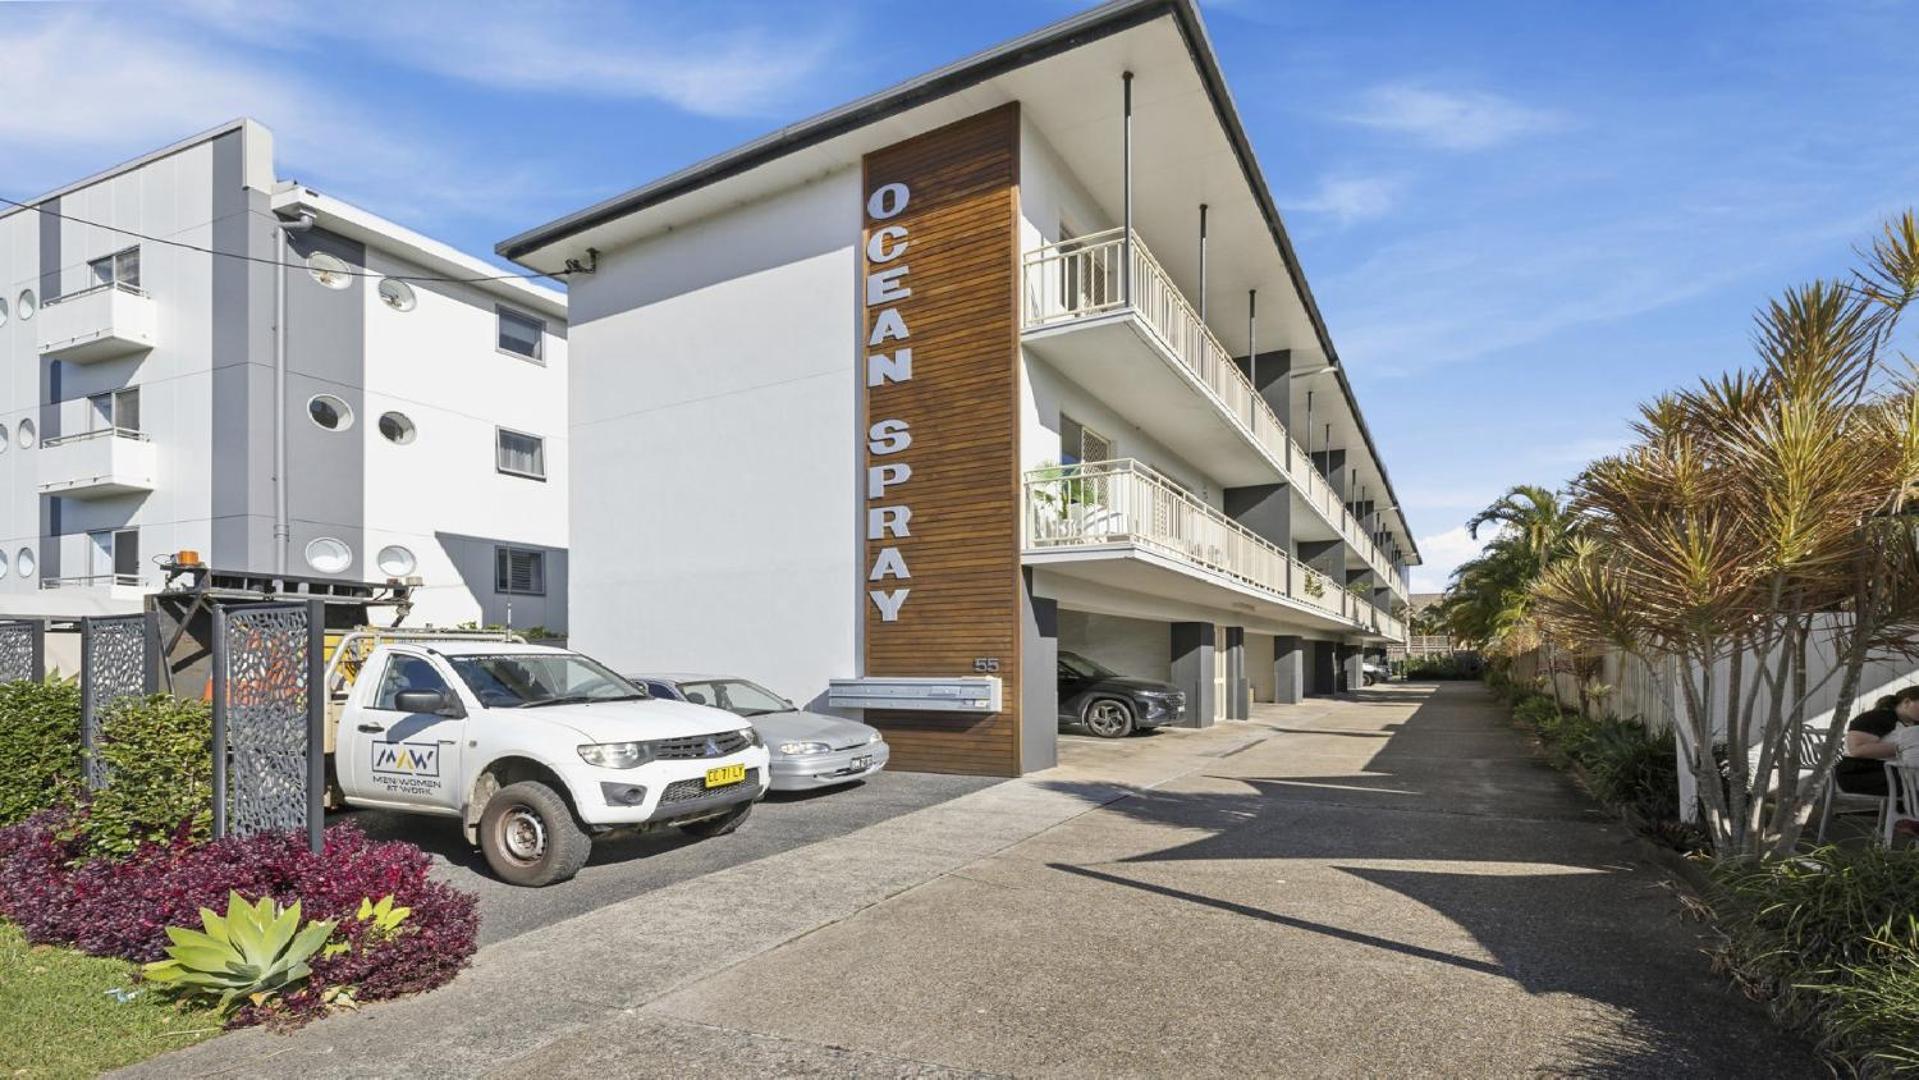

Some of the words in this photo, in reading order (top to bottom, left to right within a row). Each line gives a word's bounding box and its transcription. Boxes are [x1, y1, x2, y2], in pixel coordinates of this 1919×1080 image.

[867, 182, 912, 388] OCEAN
[867, 419, 913, 622] SPRAY
[975, 658, 1000, 672] 55
[376, 748, 434, 769] MAW
[400, 785, 433, 795] WORK
